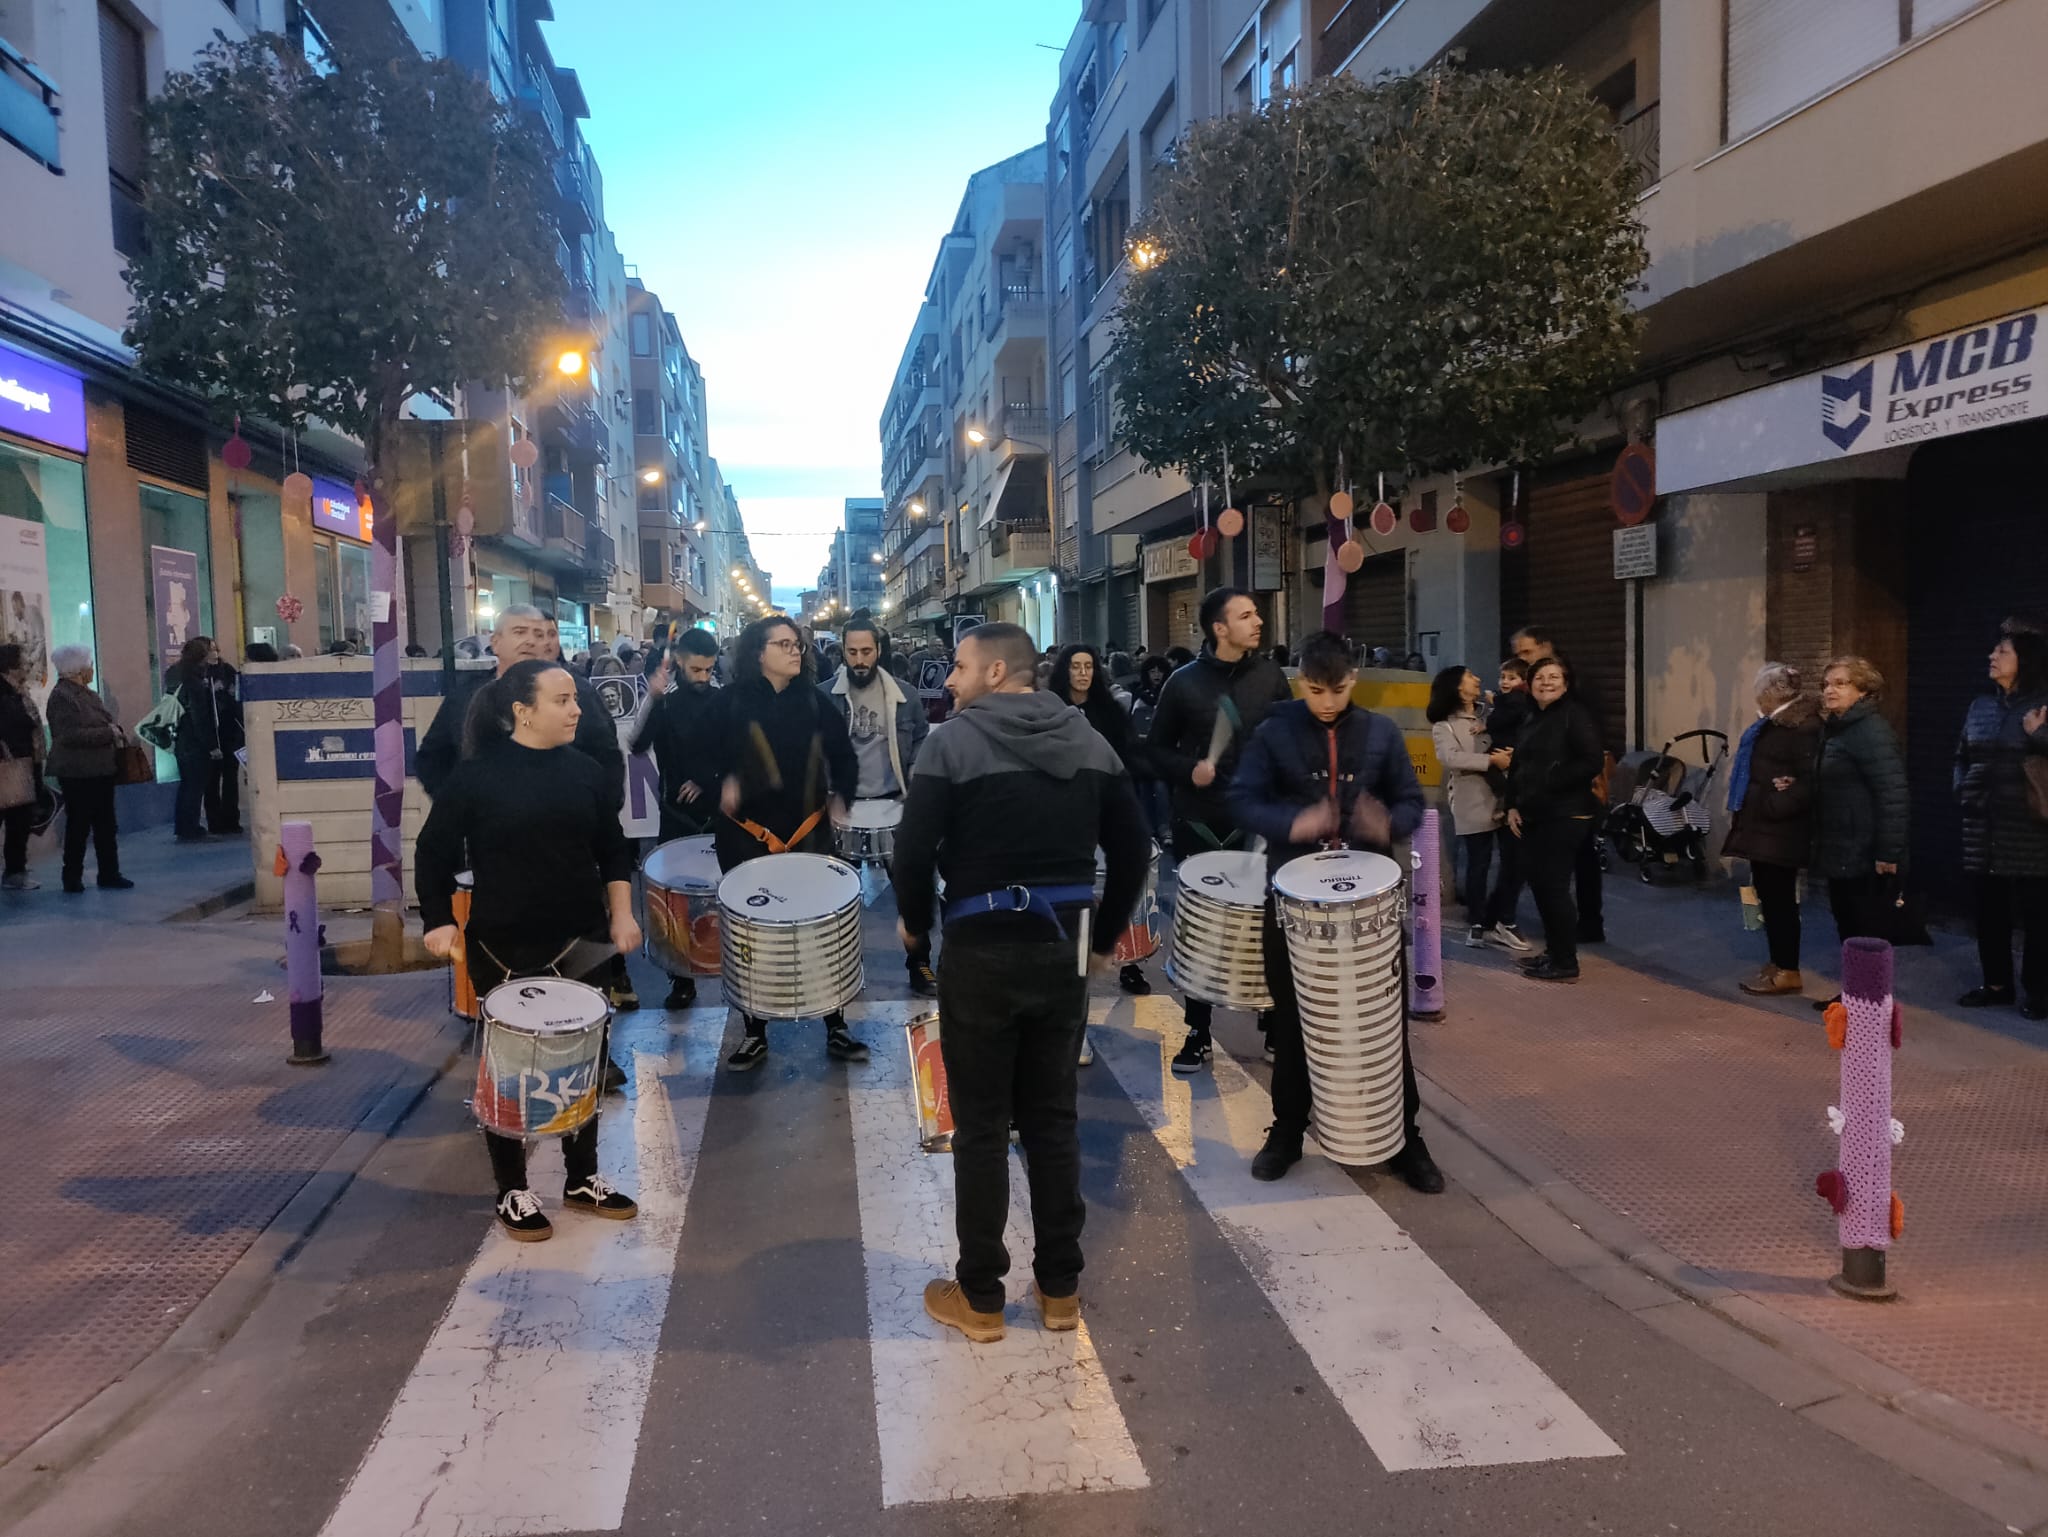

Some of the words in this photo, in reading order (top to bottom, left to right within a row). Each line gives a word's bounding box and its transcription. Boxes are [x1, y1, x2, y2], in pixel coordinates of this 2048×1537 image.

[1889, 313, 2038, 396] MCB
[1886, 374, 2033, 423] Express
[1957, 400, 2029, 426] TRANSPORTE
